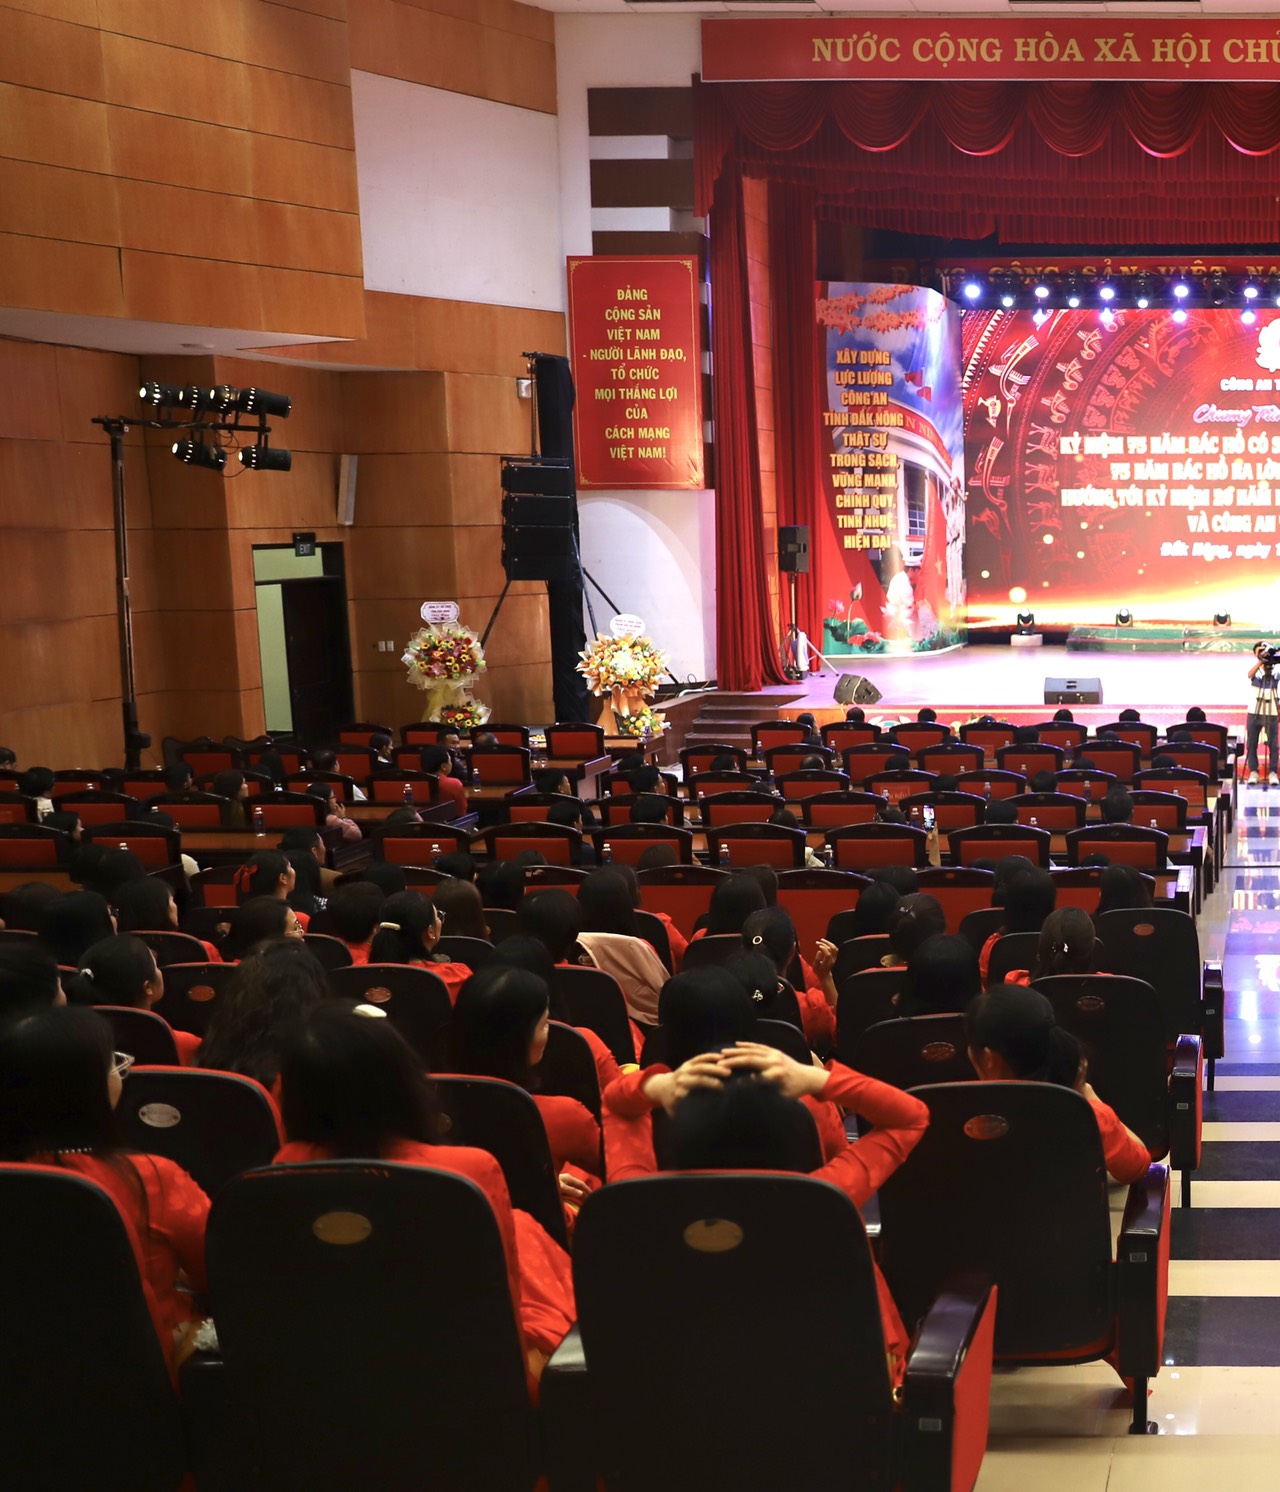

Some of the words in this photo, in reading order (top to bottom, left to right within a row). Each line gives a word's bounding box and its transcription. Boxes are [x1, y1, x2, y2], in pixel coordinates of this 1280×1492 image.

[812, 31, 900, 62] NƯỚC
[912, 31, 1003, 67] CỘNG
[1014, 30, 1084, 62] HÒA
[1093, 32, 1141, 62] XÃ
[1151, 31, 1211, 68] HỘI
[616, 284, 648, 301] ĐẢNG
[605, 306, 636, 323] CỘNG
[638, 304, 661, 321] SẢN
[607, 325, 632, 342] VIỆT
[635, 328, 661, 341] NAM
[590, 346, 624, 361] NGƯỜI
[626, 346, 657, 361] LÃNH
[659, 348, 687, 363] ĐẠO,
[836, 348, 857, 365] XÂY
[860, 349, 890, 368] DỰNG
[610, 362, 626, 380] TỔ
[629, 364, 660, 381] CHỨC
[834, 371, 856, 388] LỰC
[857, 371, 893, 388] LƯỢNG
[594, 388, 616, 402] MỌI
[618, 383, 656, 400] THẮNG
[658, 386, 678, 402] LỢI
[1220, 376, 1254, 391] CÔNG
[1255, 378, 1273, 391] AN
[840, 391, 871, 406] CÔNG
[872, 393, 888, 406] AN
[625, 403, 649, 420] CỦA
[823, 409, 849, 426] TỈNH
[850, 408, 873, 426] ĐẮK
[875, 410, 904, 427] NÔNG
[604, 424, 635, 440] CÁCH
[638, 427, 671, 441] MẠNG
[843, 432, 870, 449] THẬT
[872, 432, 889, 450] SỰ
[1060, 431, 1082, 454] KỶ
[1084, 432, 1124, 459] NIỆM
[1126, 436, 1148, 454] 75
[1150, 432, 1186, 454] NĂM
[1188, 431, 1220, 454] BÁC
[1222, 427, 1246, 454] HỒ
[1247, 431, 1269, 454] CÓ
[609, 444, 635, 461] VIỆT
[637, 446, 667, 459] NAM!
[830, 453, 866, 467] TRONG
[867, 453, 900, 470] SẠCH,
[1110, 462, 1131, 480] 75
[1134, 458, 1169, 480] NĂM
[1172, 457, 1203, 480] BÁC
[1206, 454, 1228, 480] HỒ
[1231, 462, 1254, 480] RA
[832, 470, 862, 488] VỮNG
[864, 473, 899, 490] MẠNH,
[835, 491, 870, 508] CHÍNH
[872, 494, 896, 510] QUY,
[1116, 483, 1144, 506] TỚI
[1146, 483, 1168, 506] KỶ
[1170, 484, 1210, 511] NIỆM
[1236, 485, 1272, 506] NĂM
[837, 514, 862, 528] TINH
[864, 512, 896, 530] NHUỆ,
[1187, 510, 1209, 533] VÀ
[1211, 511, 1252, 533] CÔNG
[1254, 515, 1276, 533] AN
[299, 544, 311, 554] EXIT
[844, 532, 870, 551] HIỆN
[872, 535, 891, 551] ĐẠI
